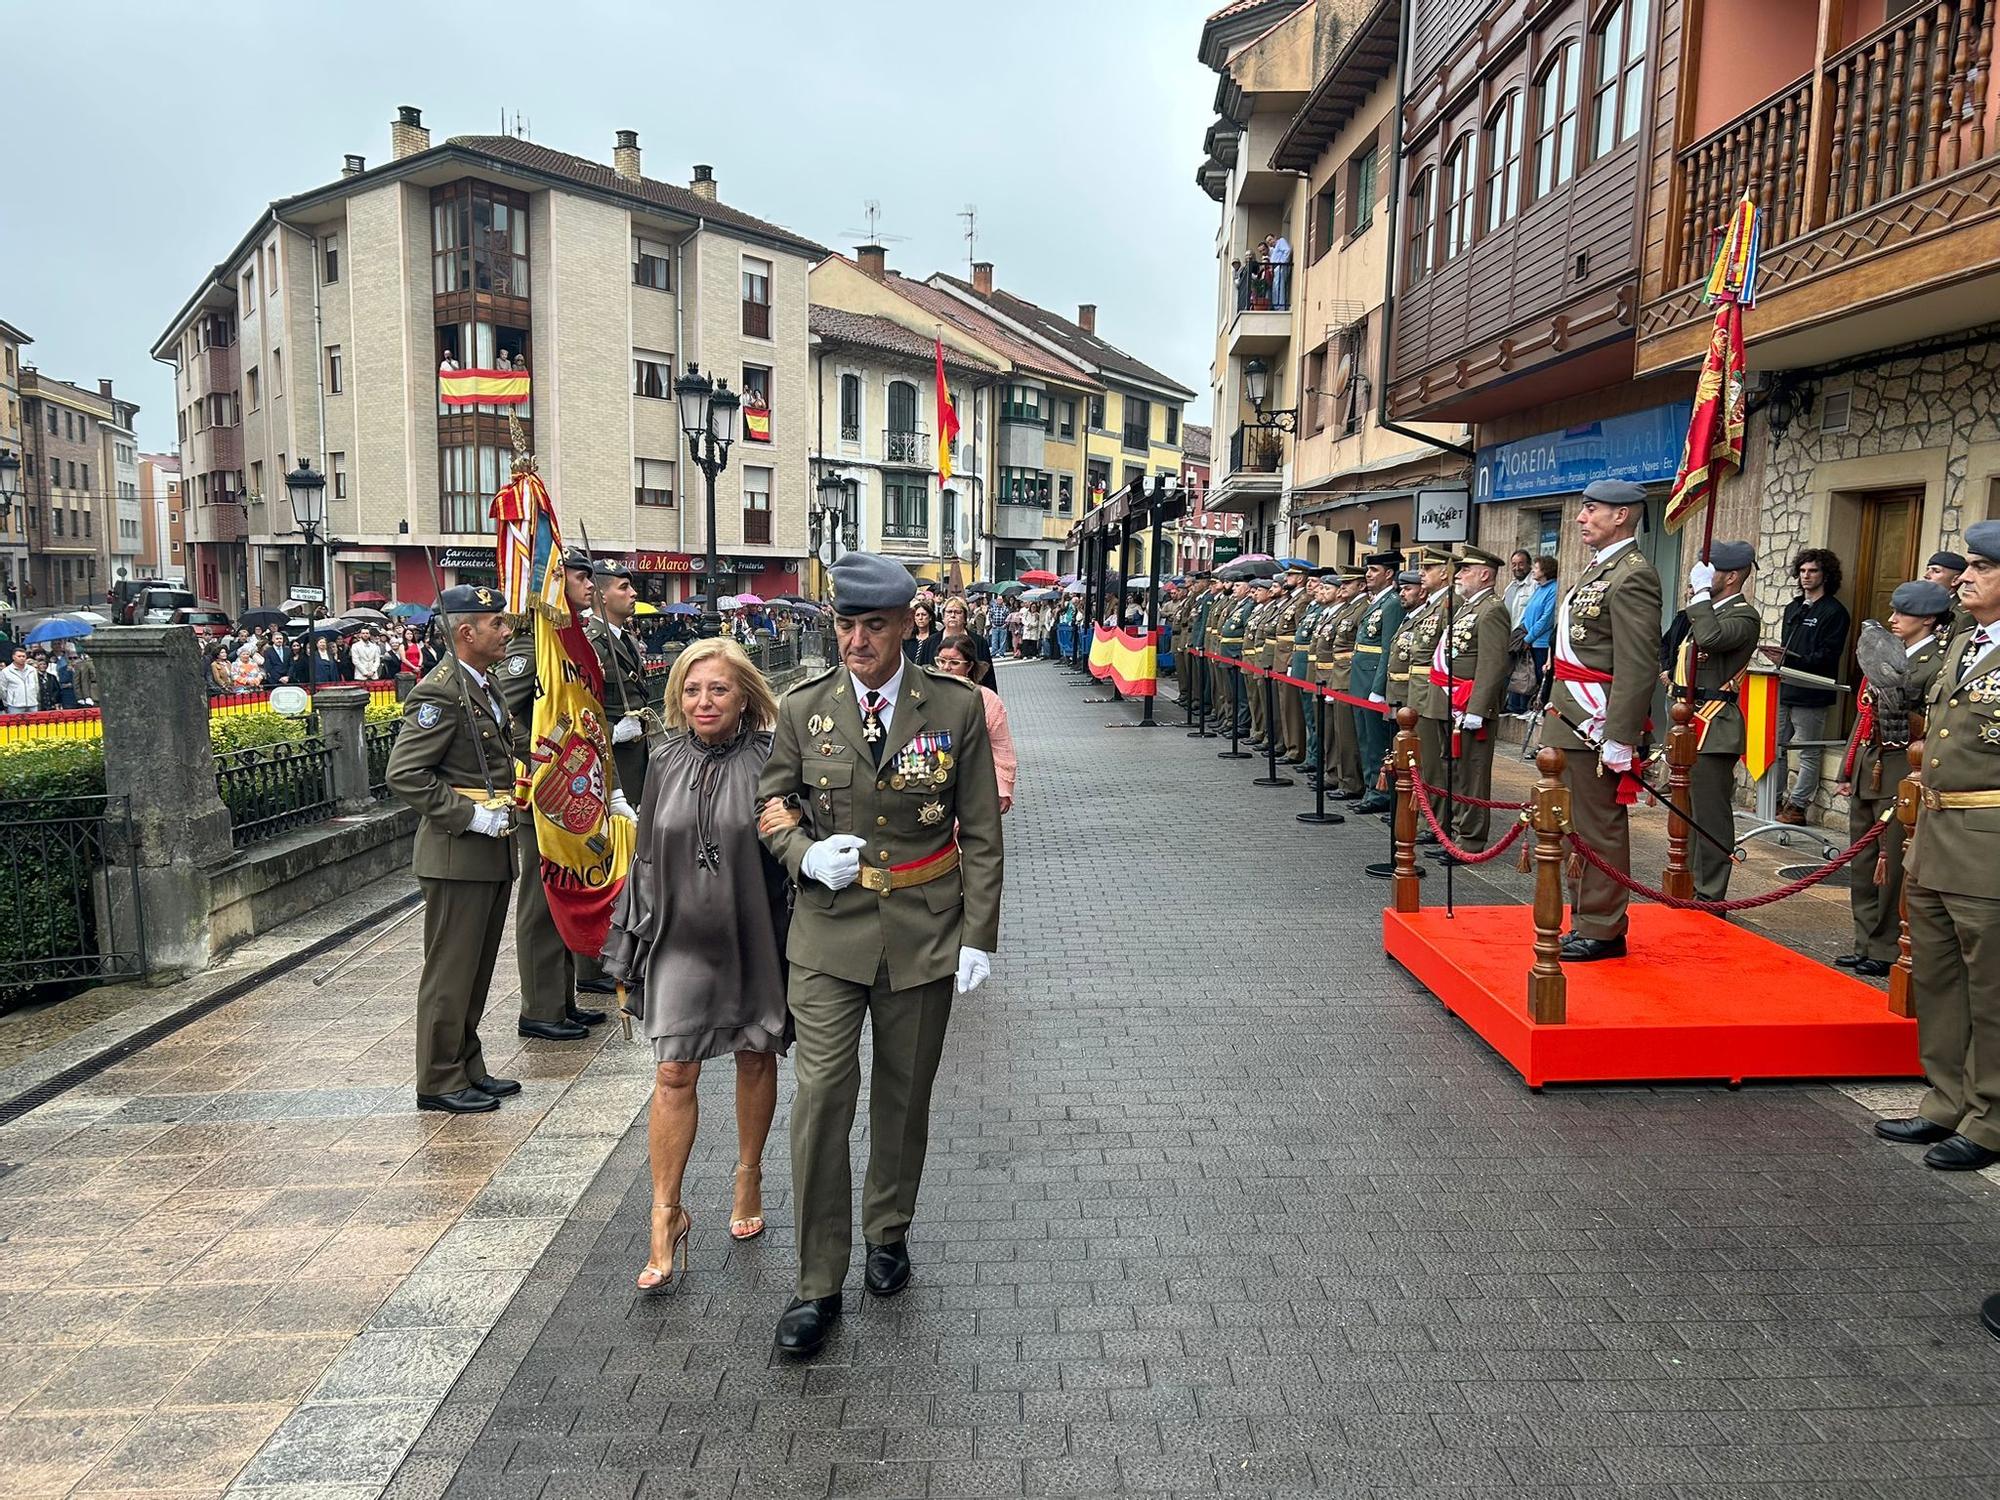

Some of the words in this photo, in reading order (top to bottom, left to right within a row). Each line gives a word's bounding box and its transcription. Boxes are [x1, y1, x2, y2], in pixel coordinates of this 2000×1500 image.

[1607, 463, 1638, 477] Comerciales
[1642, 460, 1660, 472] Naves
[639, 556, 653, 570] de
[655, 556, 689, 571] Marco
